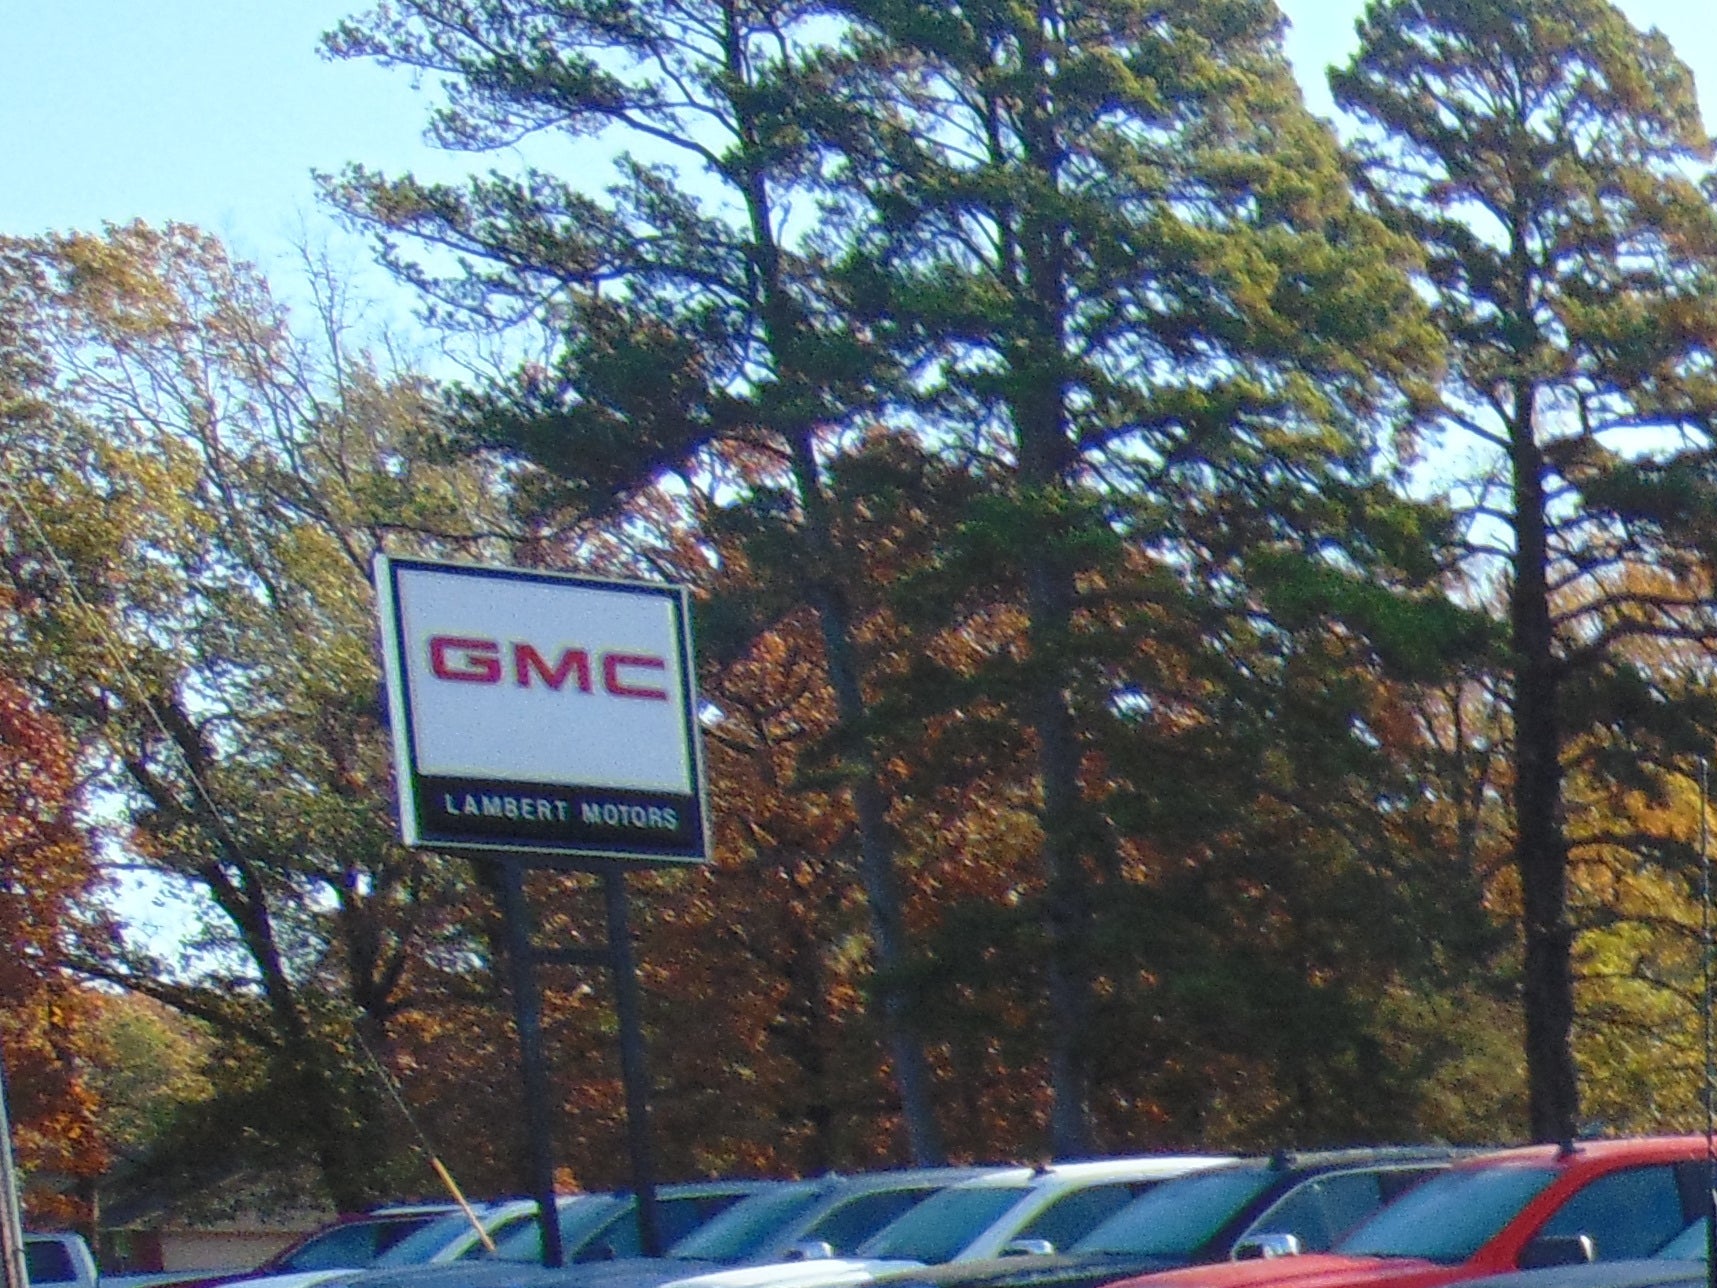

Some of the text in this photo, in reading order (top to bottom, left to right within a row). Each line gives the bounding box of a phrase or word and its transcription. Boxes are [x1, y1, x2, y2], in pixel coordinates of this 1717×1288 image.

[429, 635, 669, 701] GMC
[445, 793, 679, 830] LAMBERT MOTORS
